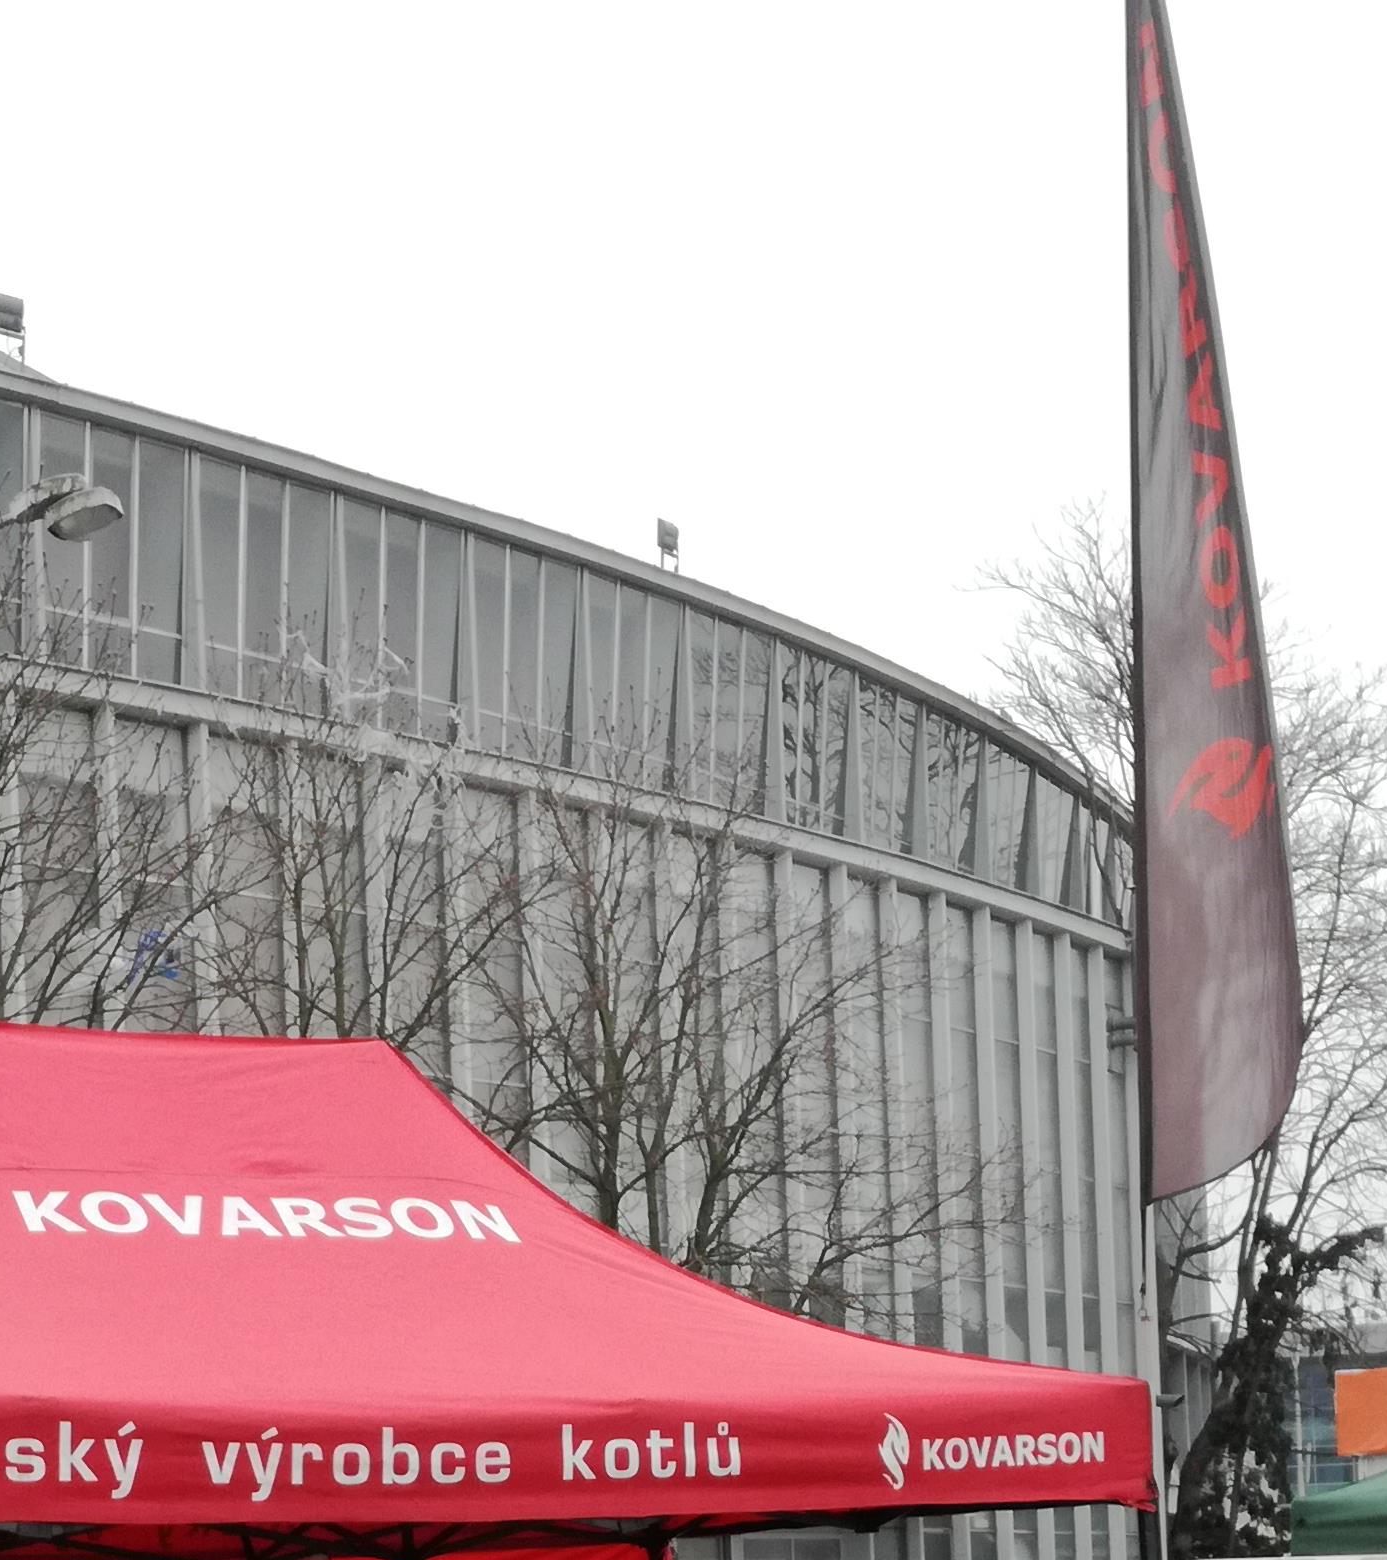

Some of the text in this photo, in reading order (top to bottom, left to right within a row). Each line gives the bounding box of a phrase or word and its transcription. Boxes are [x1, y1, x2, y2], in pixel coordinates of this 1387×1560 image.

[12, 1190, 523, 1244] KOVARSON
[201, 1426, 512, 1501] výrobce
[561, 1422, 742, 1481] kotlů
[922, 1431, 1106, 1471] KOVARSON
